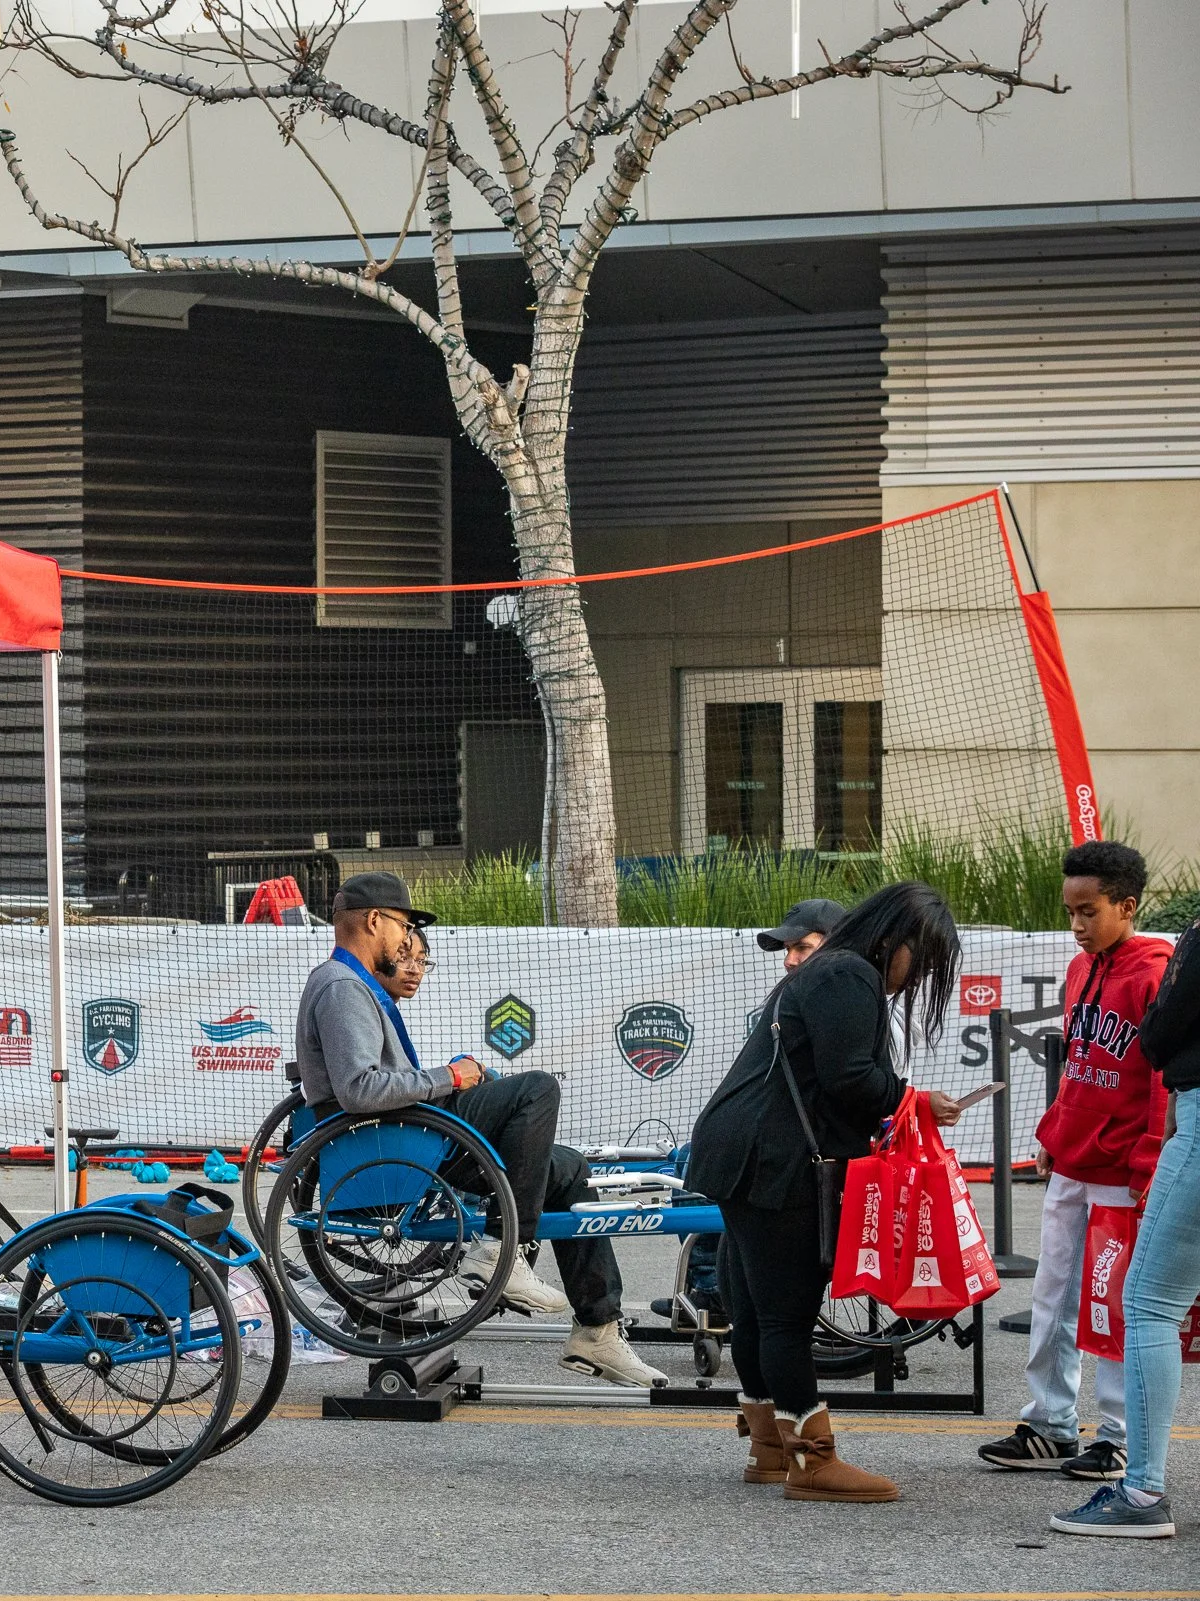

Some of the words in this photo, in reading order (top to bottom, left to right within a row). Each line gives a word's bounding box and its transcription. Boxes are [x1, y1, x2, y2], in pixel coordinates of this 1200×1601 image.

[1075, 784, 1098, 841] GoSpor
[92, 1014, 131, 1028] CYCLING
[623, 1027, 651, 1041] TRACK
[652, 1027, 659, 1037] &
[661, 1028, 685, 1042] FIELD
[214, 1046, 281, 1059] MASTERS
[196, 1060, 275, 1071] SWIMMING
[865, 1182, 875, 1191] it
[864, 1193, 874, 1225] make
[576, 1215, 619, 1234] TOP
[618, 1214, 664, 1232] END
[921, 1189, 933, 1252] easy
[862, 1227, 869, 1244] we
[1105, 1237, 1118, 1249] it
[1092, 1247, 1113, 1278] make
[1091, 1278, 1096, 1297] we
